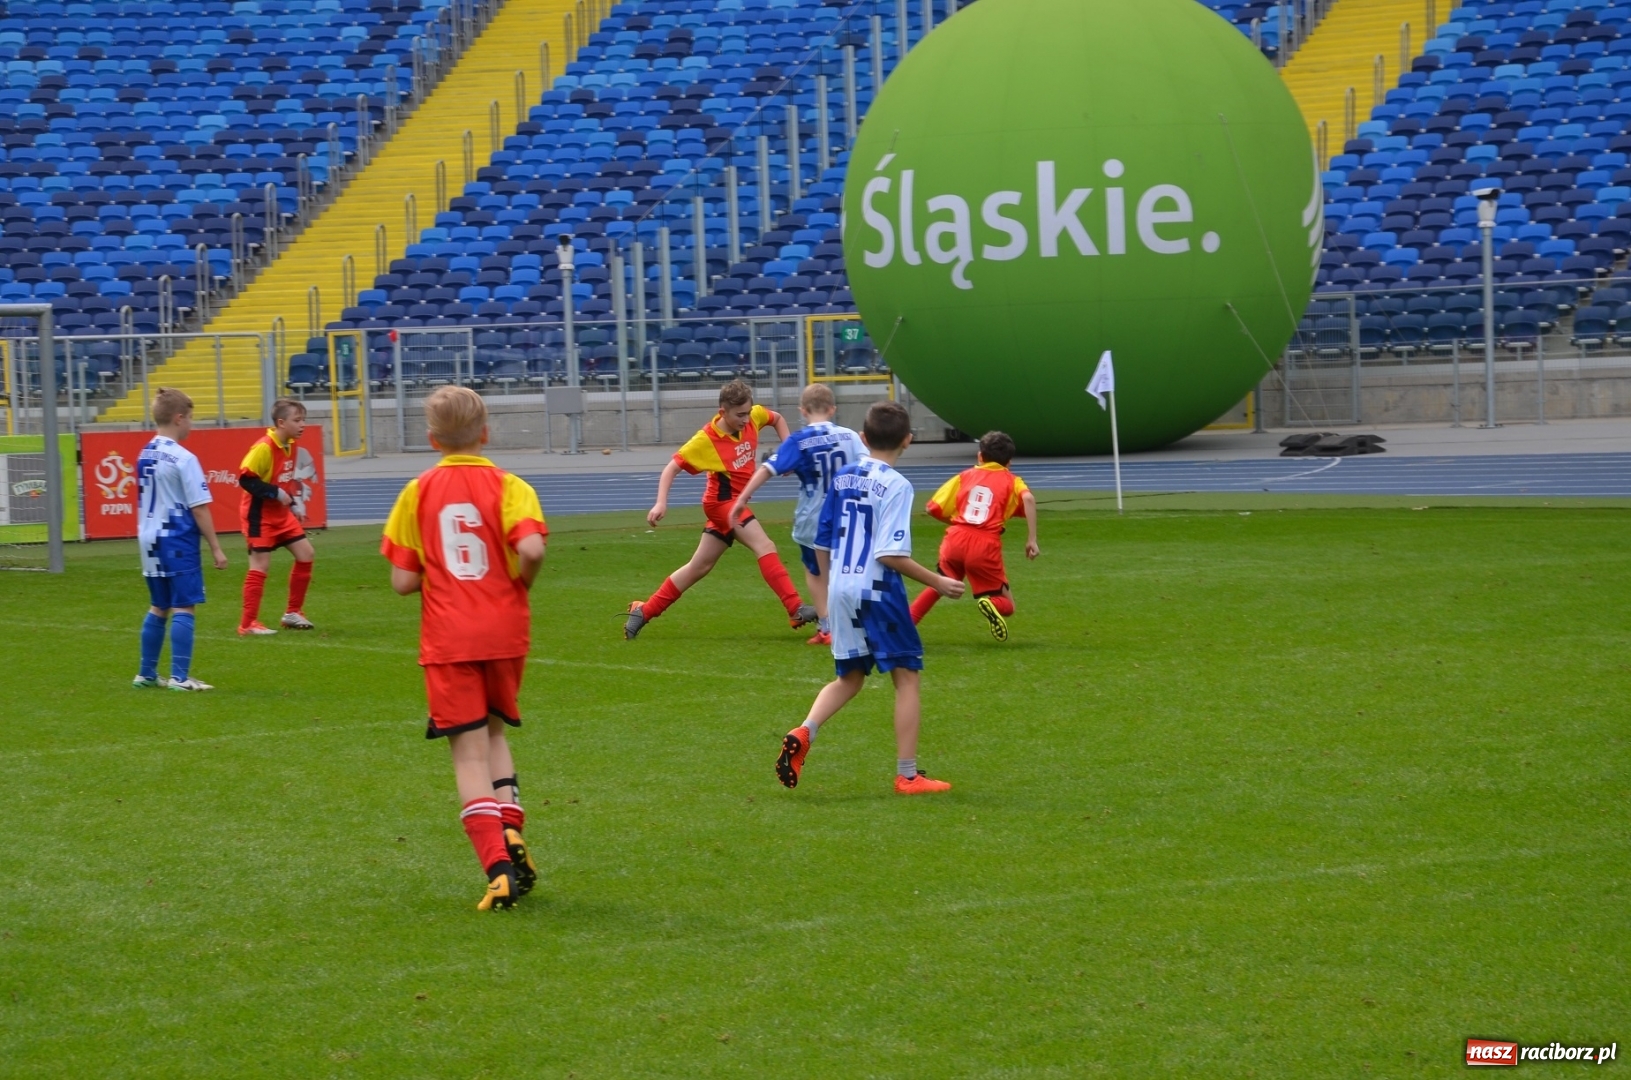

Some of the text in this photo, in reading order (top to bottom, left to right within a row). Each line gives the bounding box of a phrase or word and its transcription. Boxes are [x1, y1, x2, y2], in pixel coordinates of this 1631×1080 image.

[861, 153, 1221, 290] Śląskie.
[845, 328, 859, 340] 37
[734, 441, 751, 456] ZSG
[813, 451, 848, 494] 10
[101, 503, 133, 515] PZPN
[963, 485, 993, 525] 8
[438, 502, 489, 580] 6
[842, 500, 873, 574] 17
